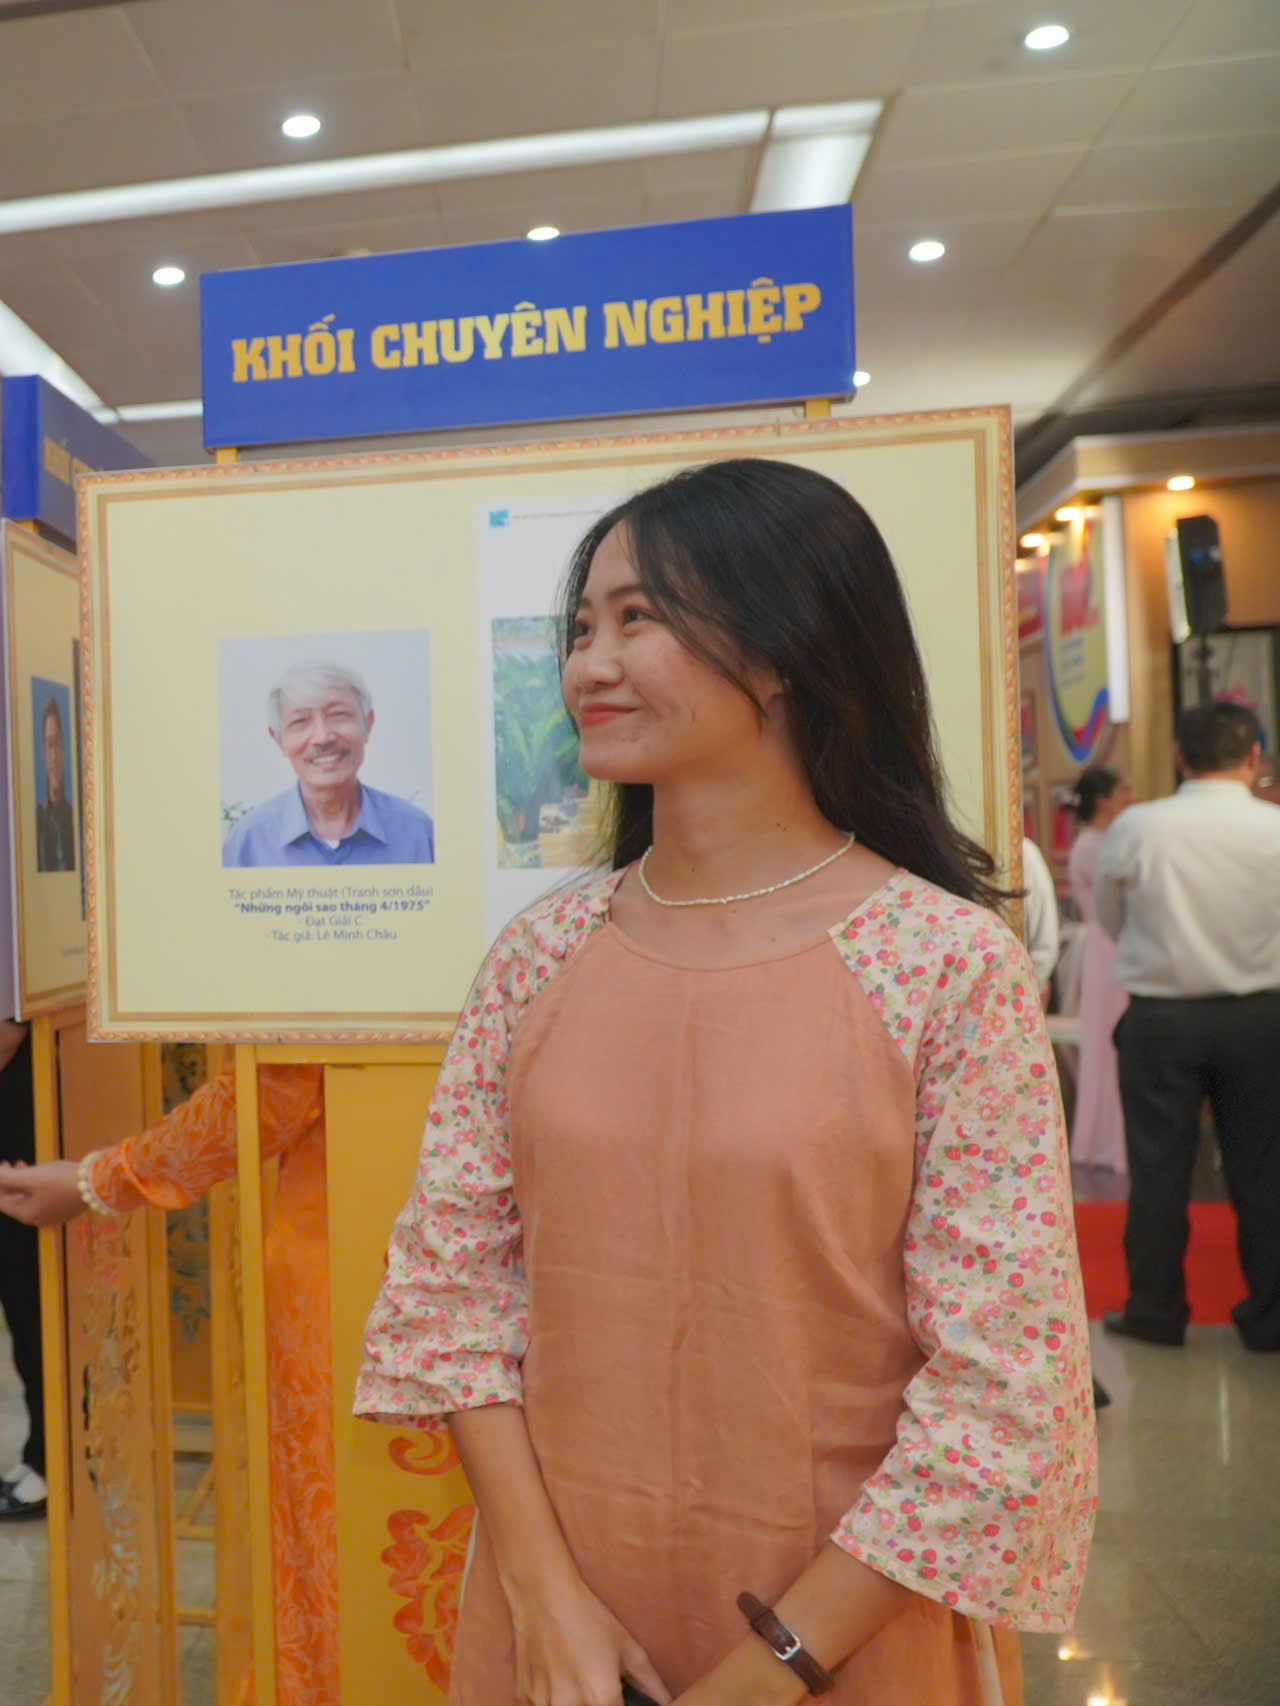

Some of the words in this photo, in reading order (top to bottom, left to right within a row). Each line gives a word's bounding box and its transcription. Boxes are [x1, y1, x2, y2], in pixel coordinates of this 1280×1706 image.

[232, 313, 355, 383] KHỐI
[370, 301, 588, 370] CHUYÊN
[603, 277, 821, 350] NGHIỆP
[284, 900, 313, 914] ngôi
[315, 903, 337, 913] sao
[340, 900, 377, 914] tháng
[334, 927, 362, 940] Minh
